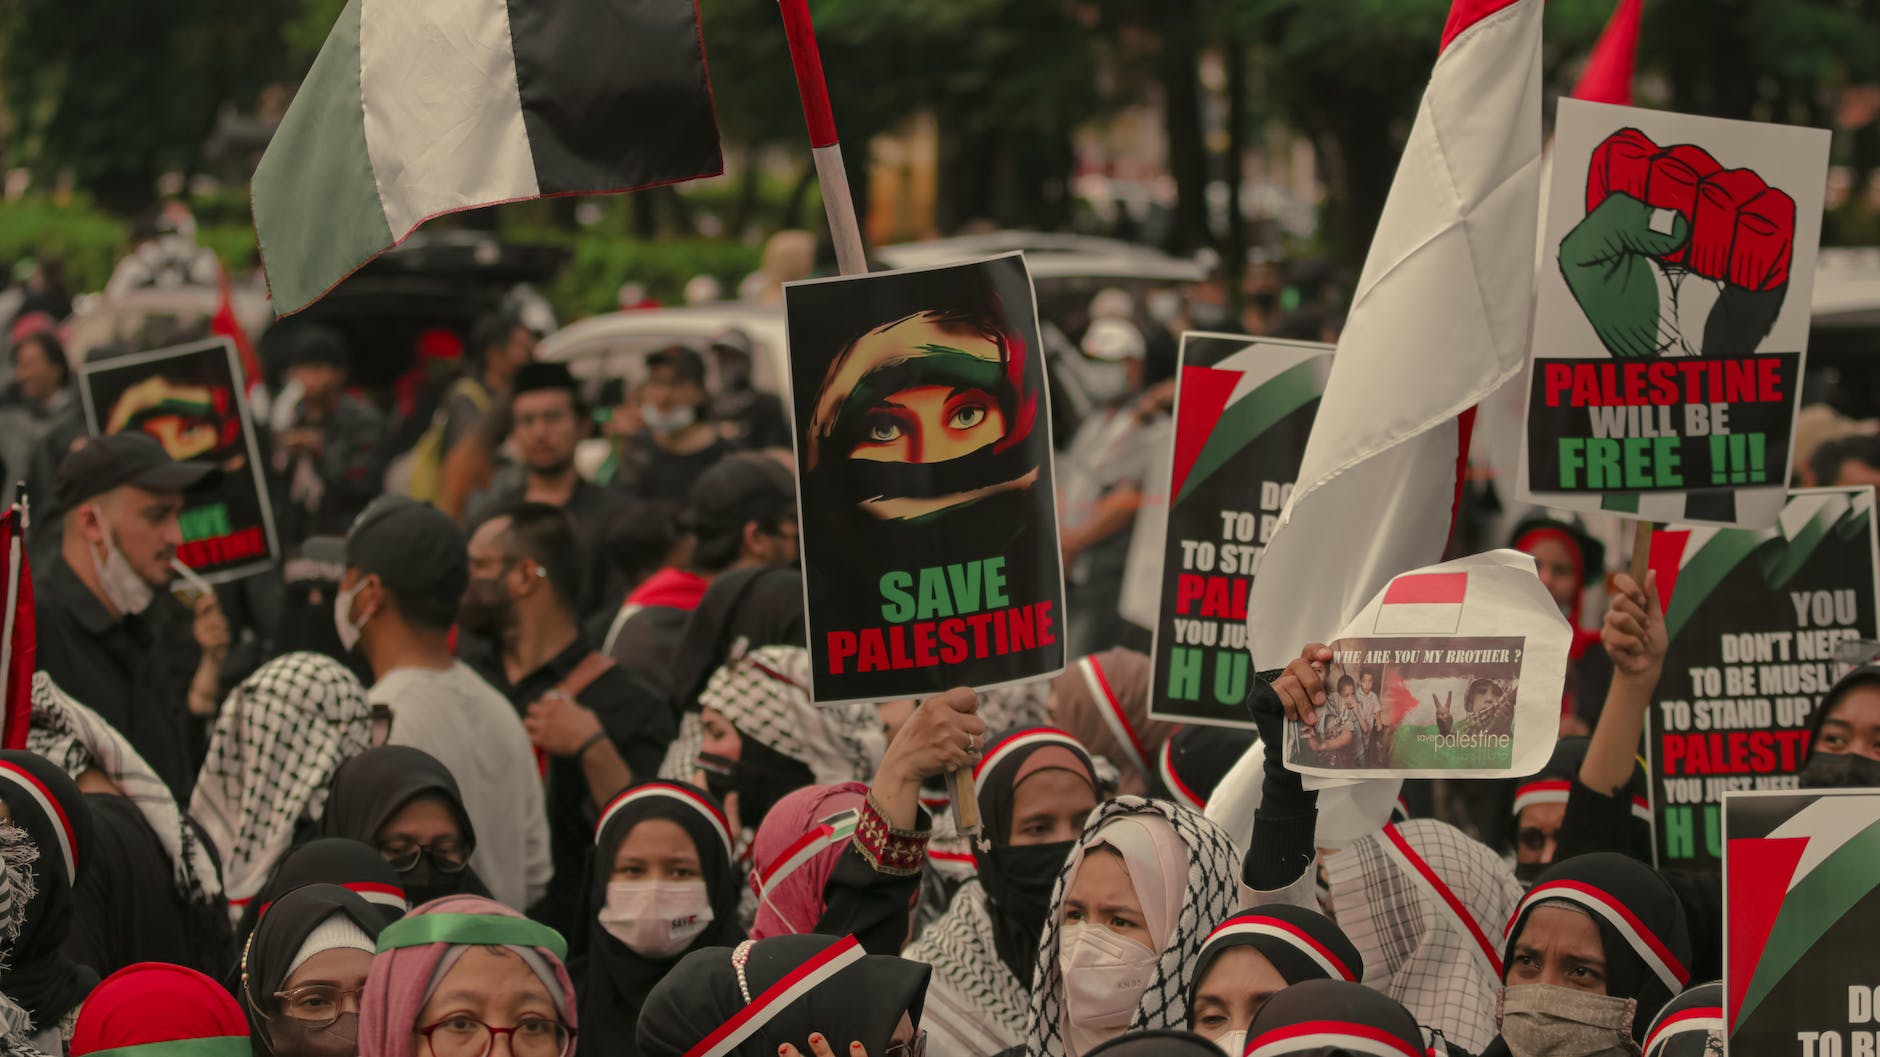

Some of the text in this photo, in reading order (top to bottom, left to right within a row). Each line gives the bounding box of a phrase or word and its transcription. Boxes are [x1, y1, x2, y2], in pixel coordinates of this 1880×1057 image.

[1545, 358, 1783, 407] PALESTINE
[1588, 402, 1730, 438] WILL BE
[1558, 432, 1766, 488] FREE !!!
[1221, 510, 1255, 542] TO
[1181, 540, 1215, 572] TO
[879, 556, 1009, 623] SAVE
[1790, 589, 1857, 627] YOU
[827, 600, 1056, 675] PALESTINE
[1173, 618, 1250, 649] YOU JU
[1721, 632, 1793, 663] DON'T
[1363, 650, 1391, 664] ARE
[1394, 650, 1420, 664] YOU
[1422, 650, 1444, 664] MY
[1446, 649, 1510, 663] BROTHER
[1689, 667, 1722, 697] TO
[1725, 666, 1756, 696] BE
[1660, 700, 1691, 731] TO
[1694, 698, 1772, 730] STAND
[1775, 697, 1811, 728] UP
[1434, 730, 1510, 752] palestine
[1663, 777, 1702, 803] YOU
